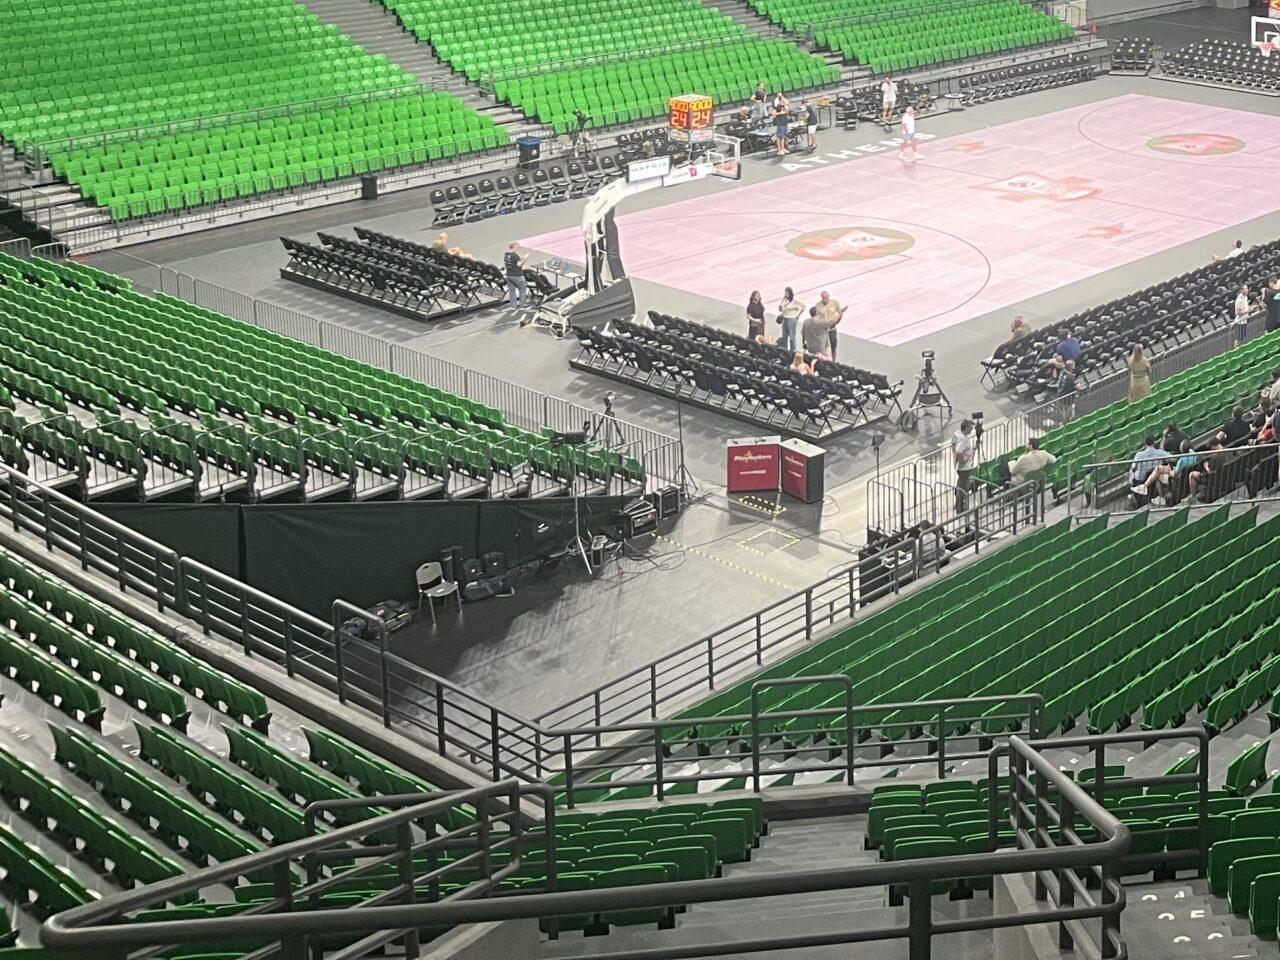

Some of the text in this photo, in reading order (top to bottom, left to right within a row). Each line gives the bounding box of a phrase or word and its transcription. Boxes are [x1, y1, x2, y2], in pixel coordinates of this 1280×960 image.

[671, 110, 687, 127] 24
[692, 110, 711, 127] 24
[780, 132, 936, 171] ATHENS
[631, 162, 668, 172] MATRIX
